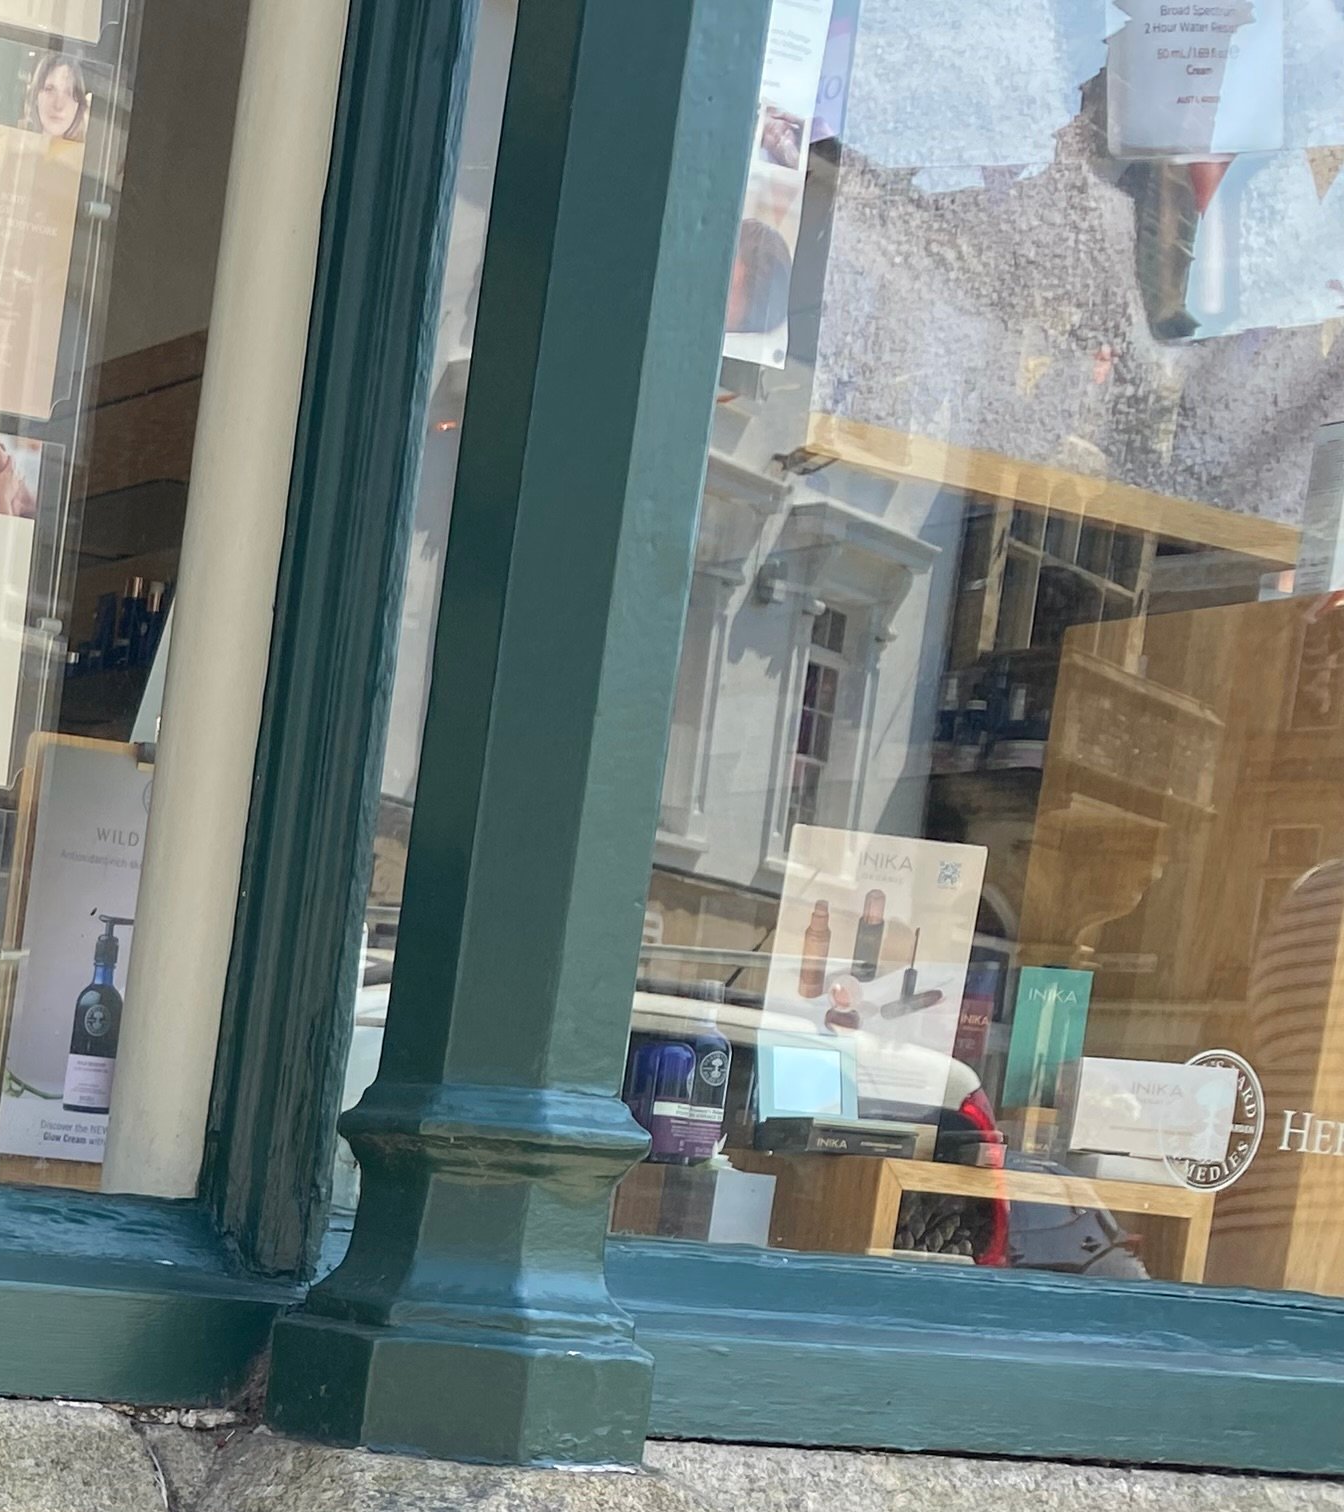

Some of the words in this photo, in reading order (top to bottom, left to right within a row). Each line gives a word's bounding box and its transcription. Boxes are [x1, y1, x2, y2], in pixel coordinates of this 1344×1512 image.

[1144, 22, 1151, 34] 2
[97, 827, 140, 847] WILD
[859, 851, 913, 872] INIKA
[1131, 1081, 1185, 1097] INIKA
[41, 1120, 72, 1132] Discover
[75, 1123, 88, 1133] the
[63, 1134, 87, 1145] Cream
[816, 1138, 847, 1149] INIKA
[1185, 1140, 1249, 1182] MEDIES
